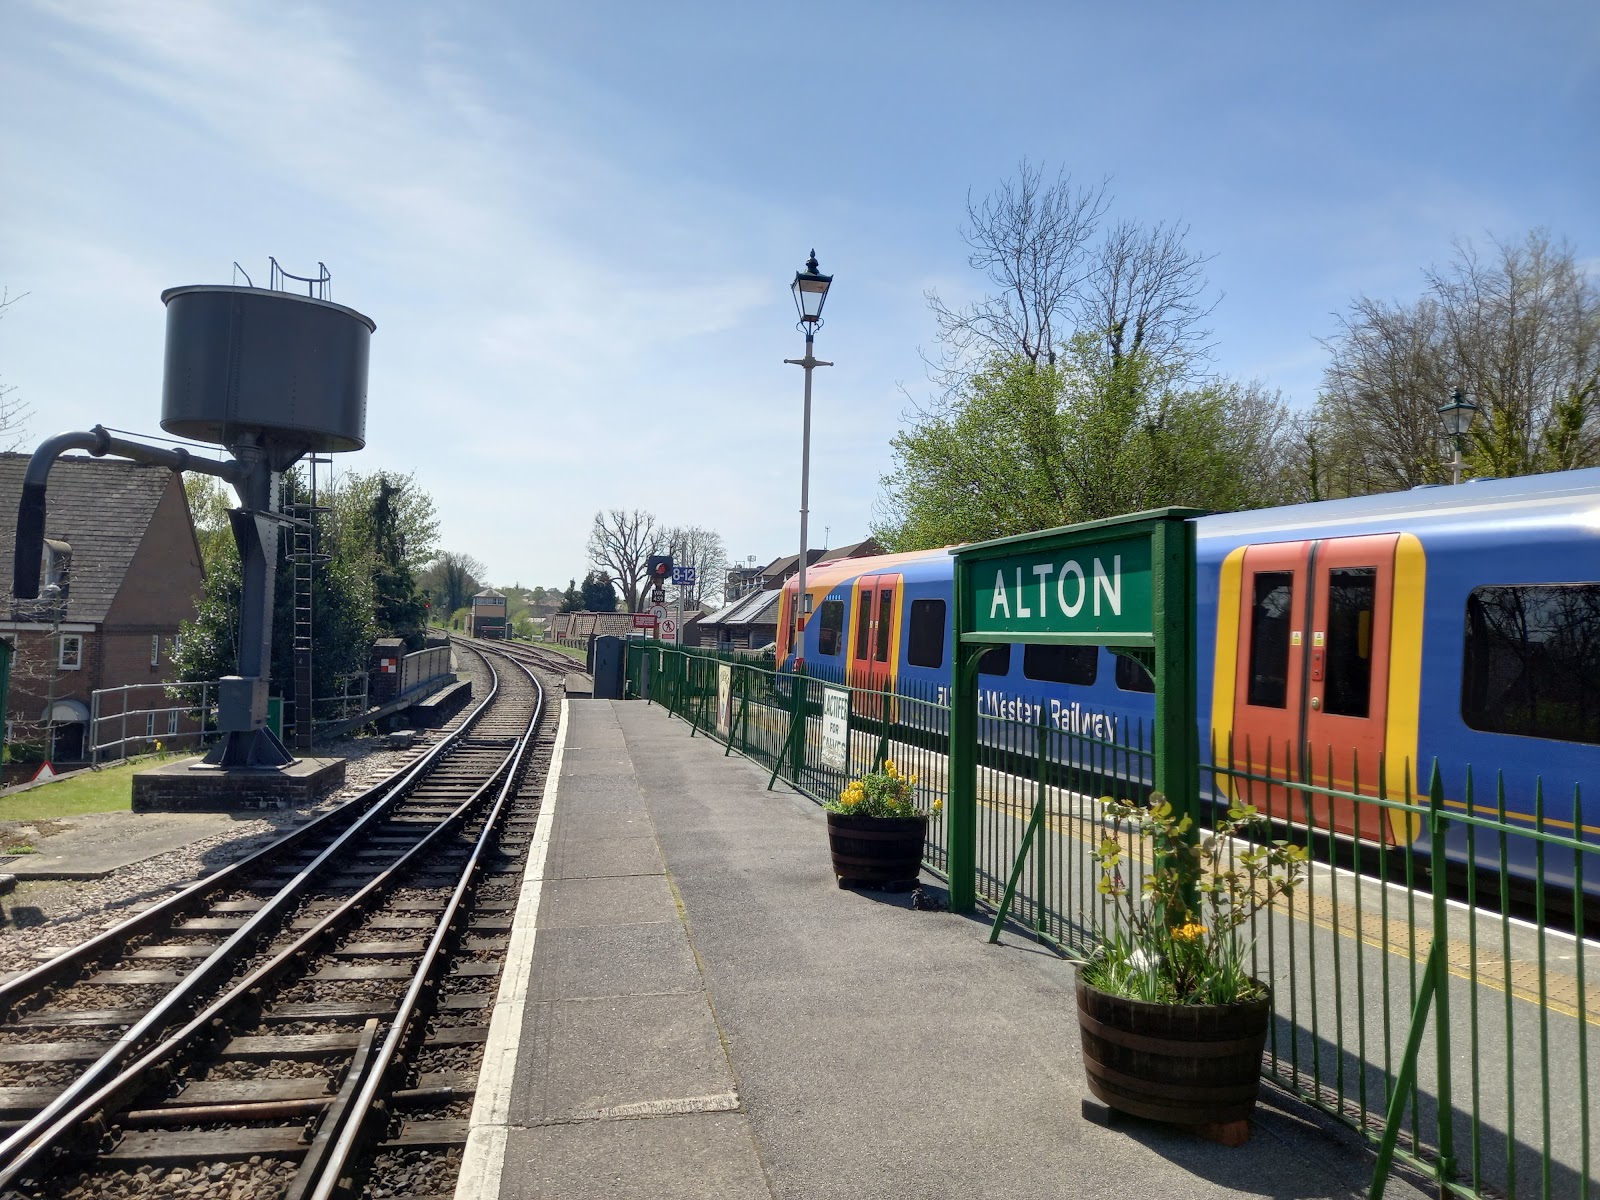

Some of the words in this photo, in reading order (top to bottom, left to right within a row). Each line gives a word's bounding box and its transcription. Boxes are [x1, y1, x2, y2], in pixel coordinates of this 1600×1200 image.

[672, 568, 694, 581] 8-12
[990, 554, 1121, 618] ALTON
[830, 722, 840, 735] FOR
[1050, 699, 1118, 742] Railway
